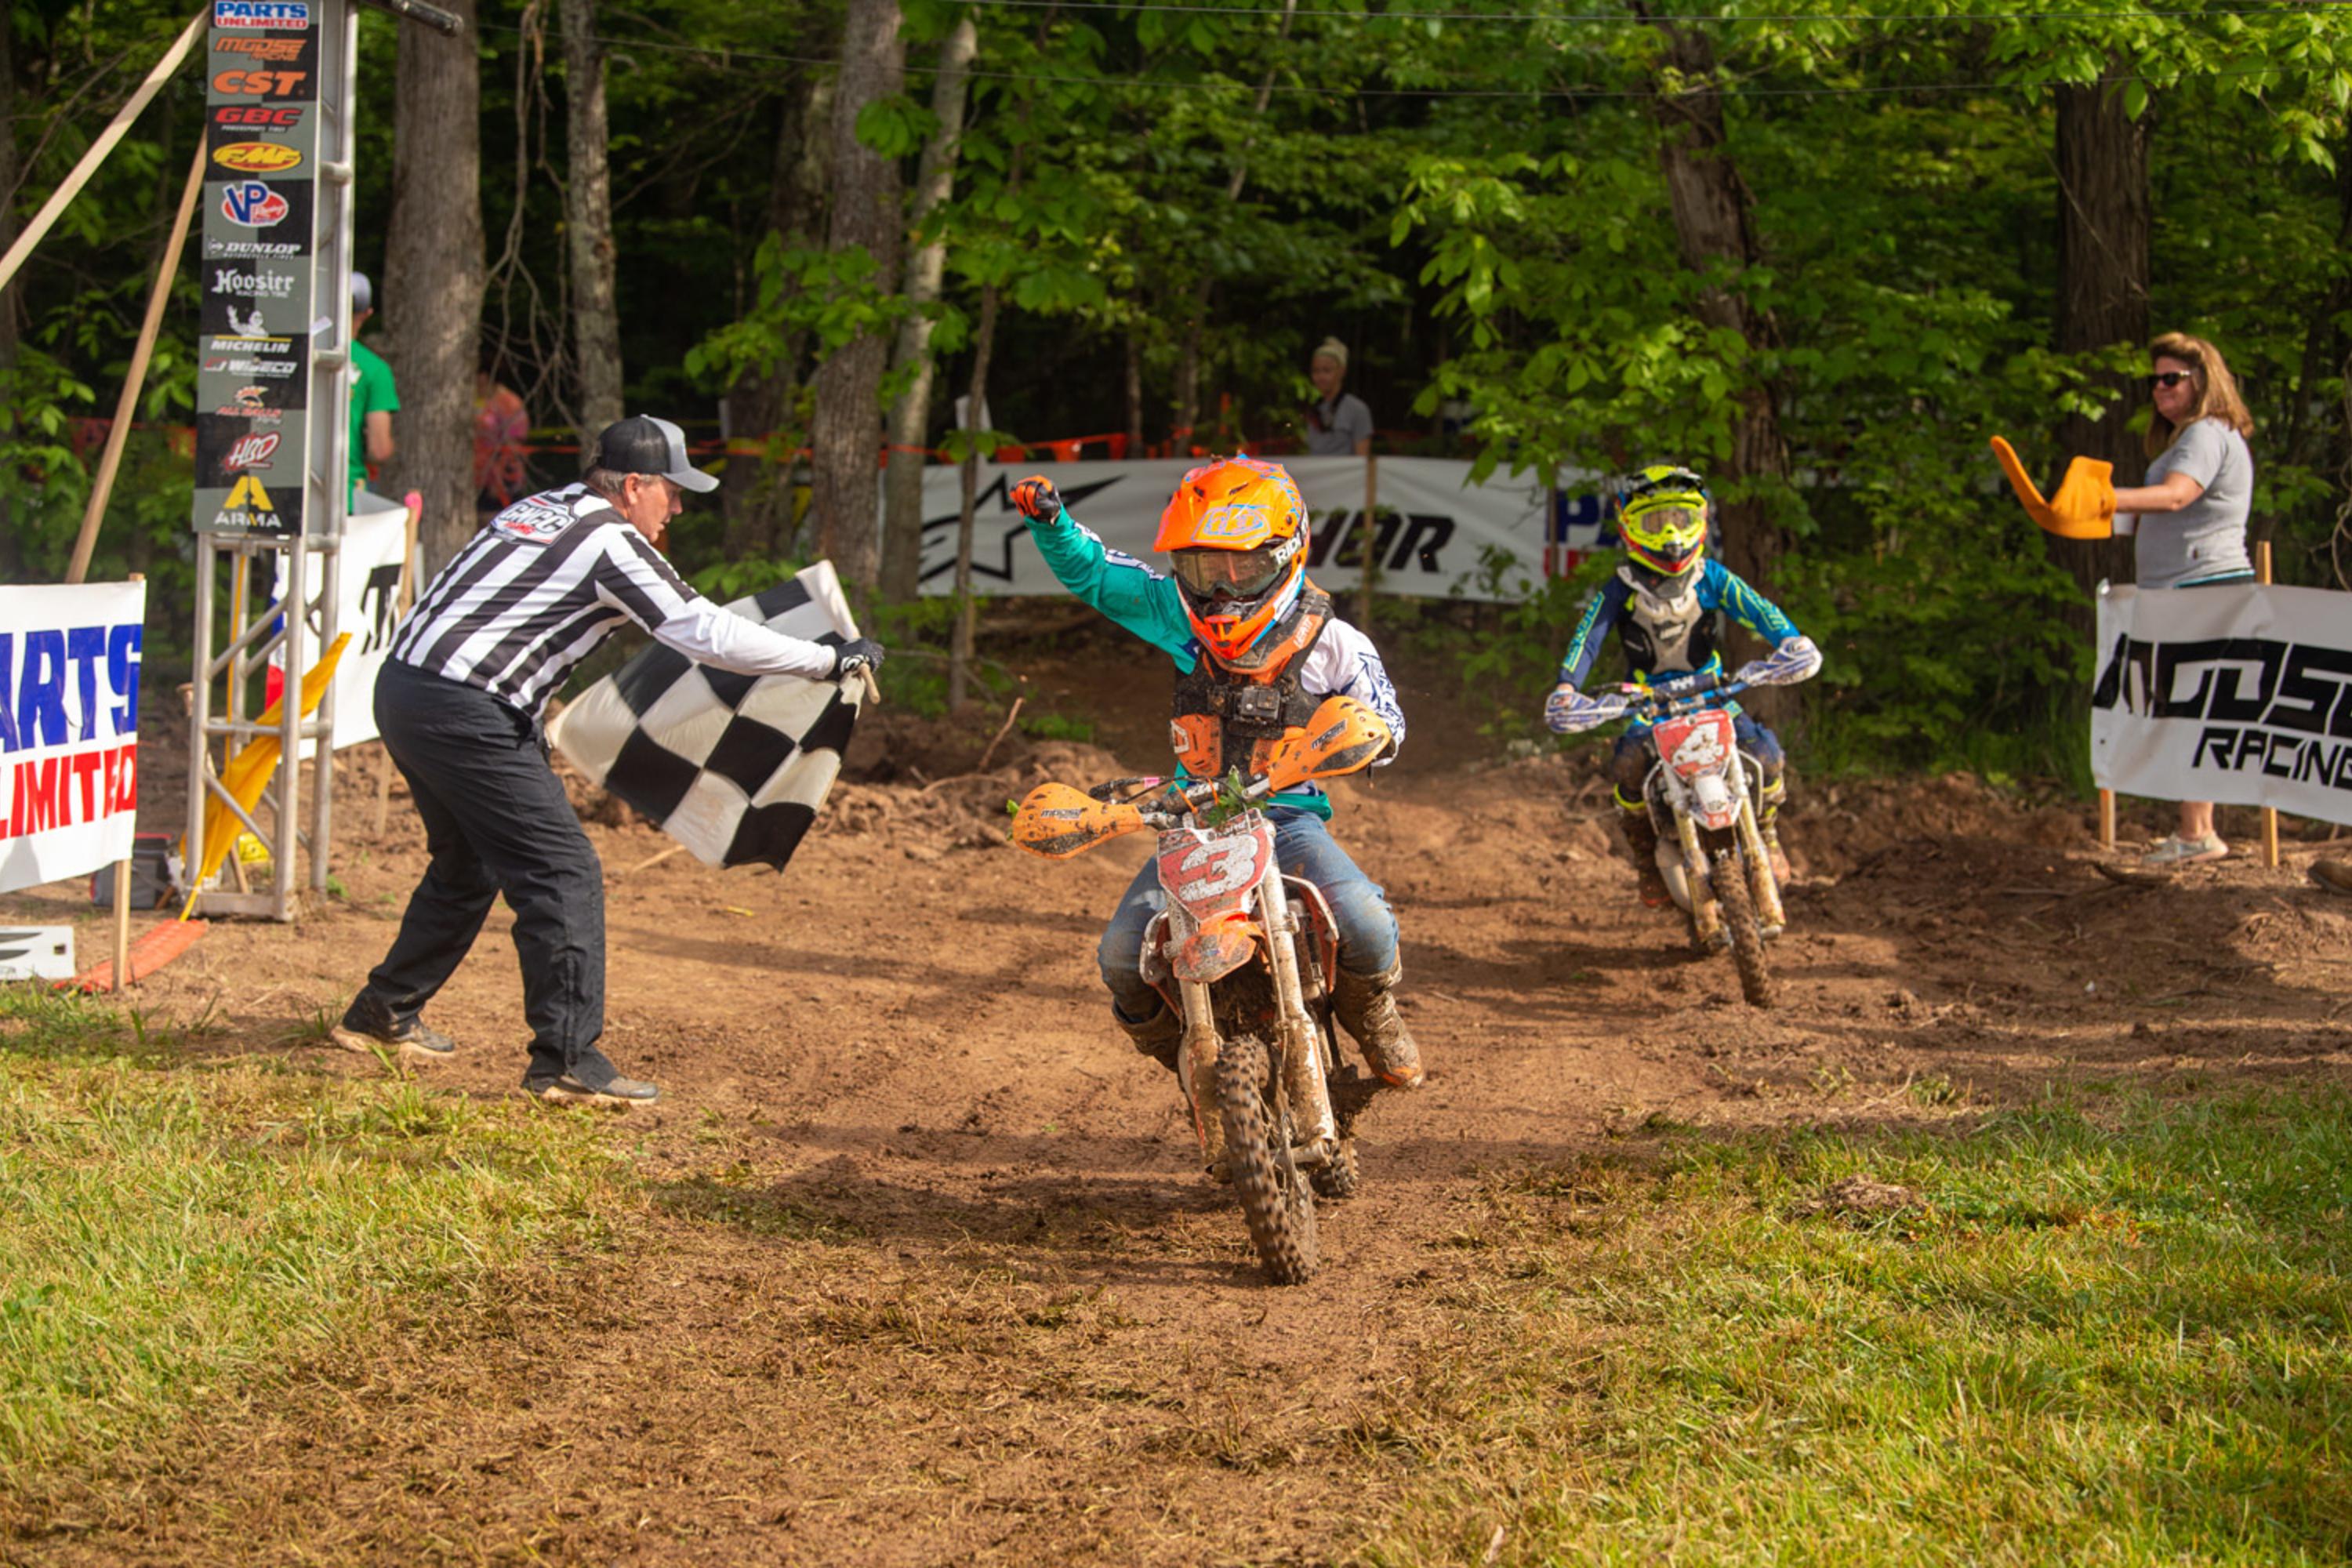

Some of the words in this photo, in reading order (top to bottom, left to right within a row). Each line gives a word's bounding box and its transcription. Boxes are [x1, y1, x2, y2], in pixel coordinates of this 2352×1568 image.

[217, 2, 307, 17] PARTS
[217, 17, 307, 28] UNLIMITED
[215, 37, 307, 53] MOOSE
[212, 68, 307, 96] CST
[215, 107, 303, 125] GBC
[213, 147, 301, 164] FMF
[225, 183, 268, 224] VP
[225, 242, 301, 254] DUNLOP
[211, 268, 295, 293] Hoosier
[211, 340, 290, 353] MICHELIN
[214, 511, 282, 528] ARMA
[1308, 510, 1457, 573] HOR
[1671, 721, 1725, 766] 4
[1178, 835, 1258, 902] 3
